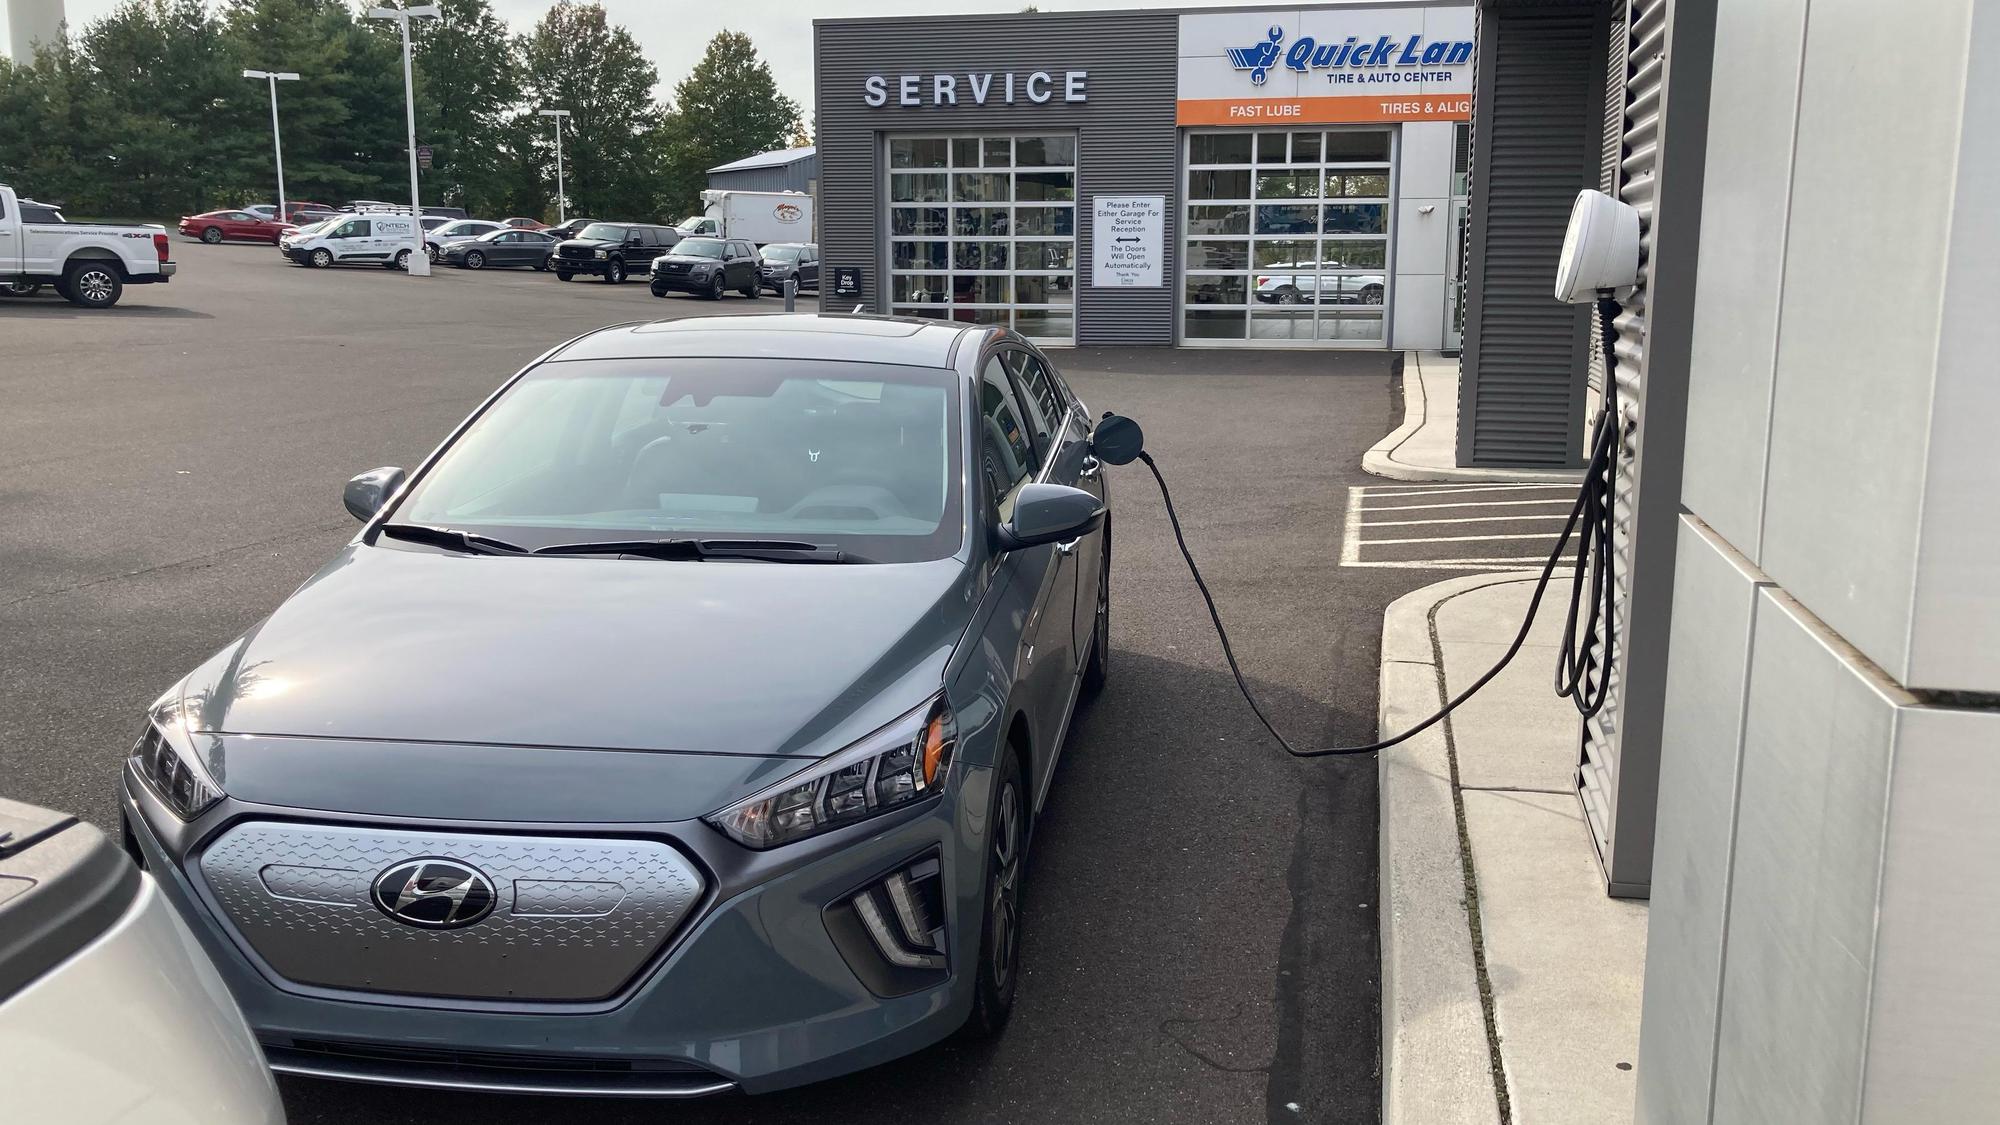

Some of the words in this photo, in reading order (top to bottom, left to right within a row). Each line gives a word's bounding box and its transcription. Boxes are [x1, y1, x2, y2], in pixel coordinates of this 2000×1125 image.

[1285, 36, 1397, 72] Quick
[1327, 74, 1354, 83] TIRE
[1357, 74, 1365, 82] &
[1368, 73, 1401, 82] AUTO
[1404, 72, 1452, 81] CENTER
[864, 71, 1088, 107] SERVICE
[1230, 105, 1263, 117] FAST
[1266, 105, 1301, 116] LUBE
[1381, 102, 1420, 114] TIRES
[1424, 102, 1433, 113] &
[1106, 201, 1130, 209] Please
[1132, 201, 1151, 209] Enter
[1120, 210, 1146, 218] Garage
[1148, 209, 1159, 217] For
[1126, 252, 1145, 261] Open
[1104, 262, 1152, 270] Automatically
